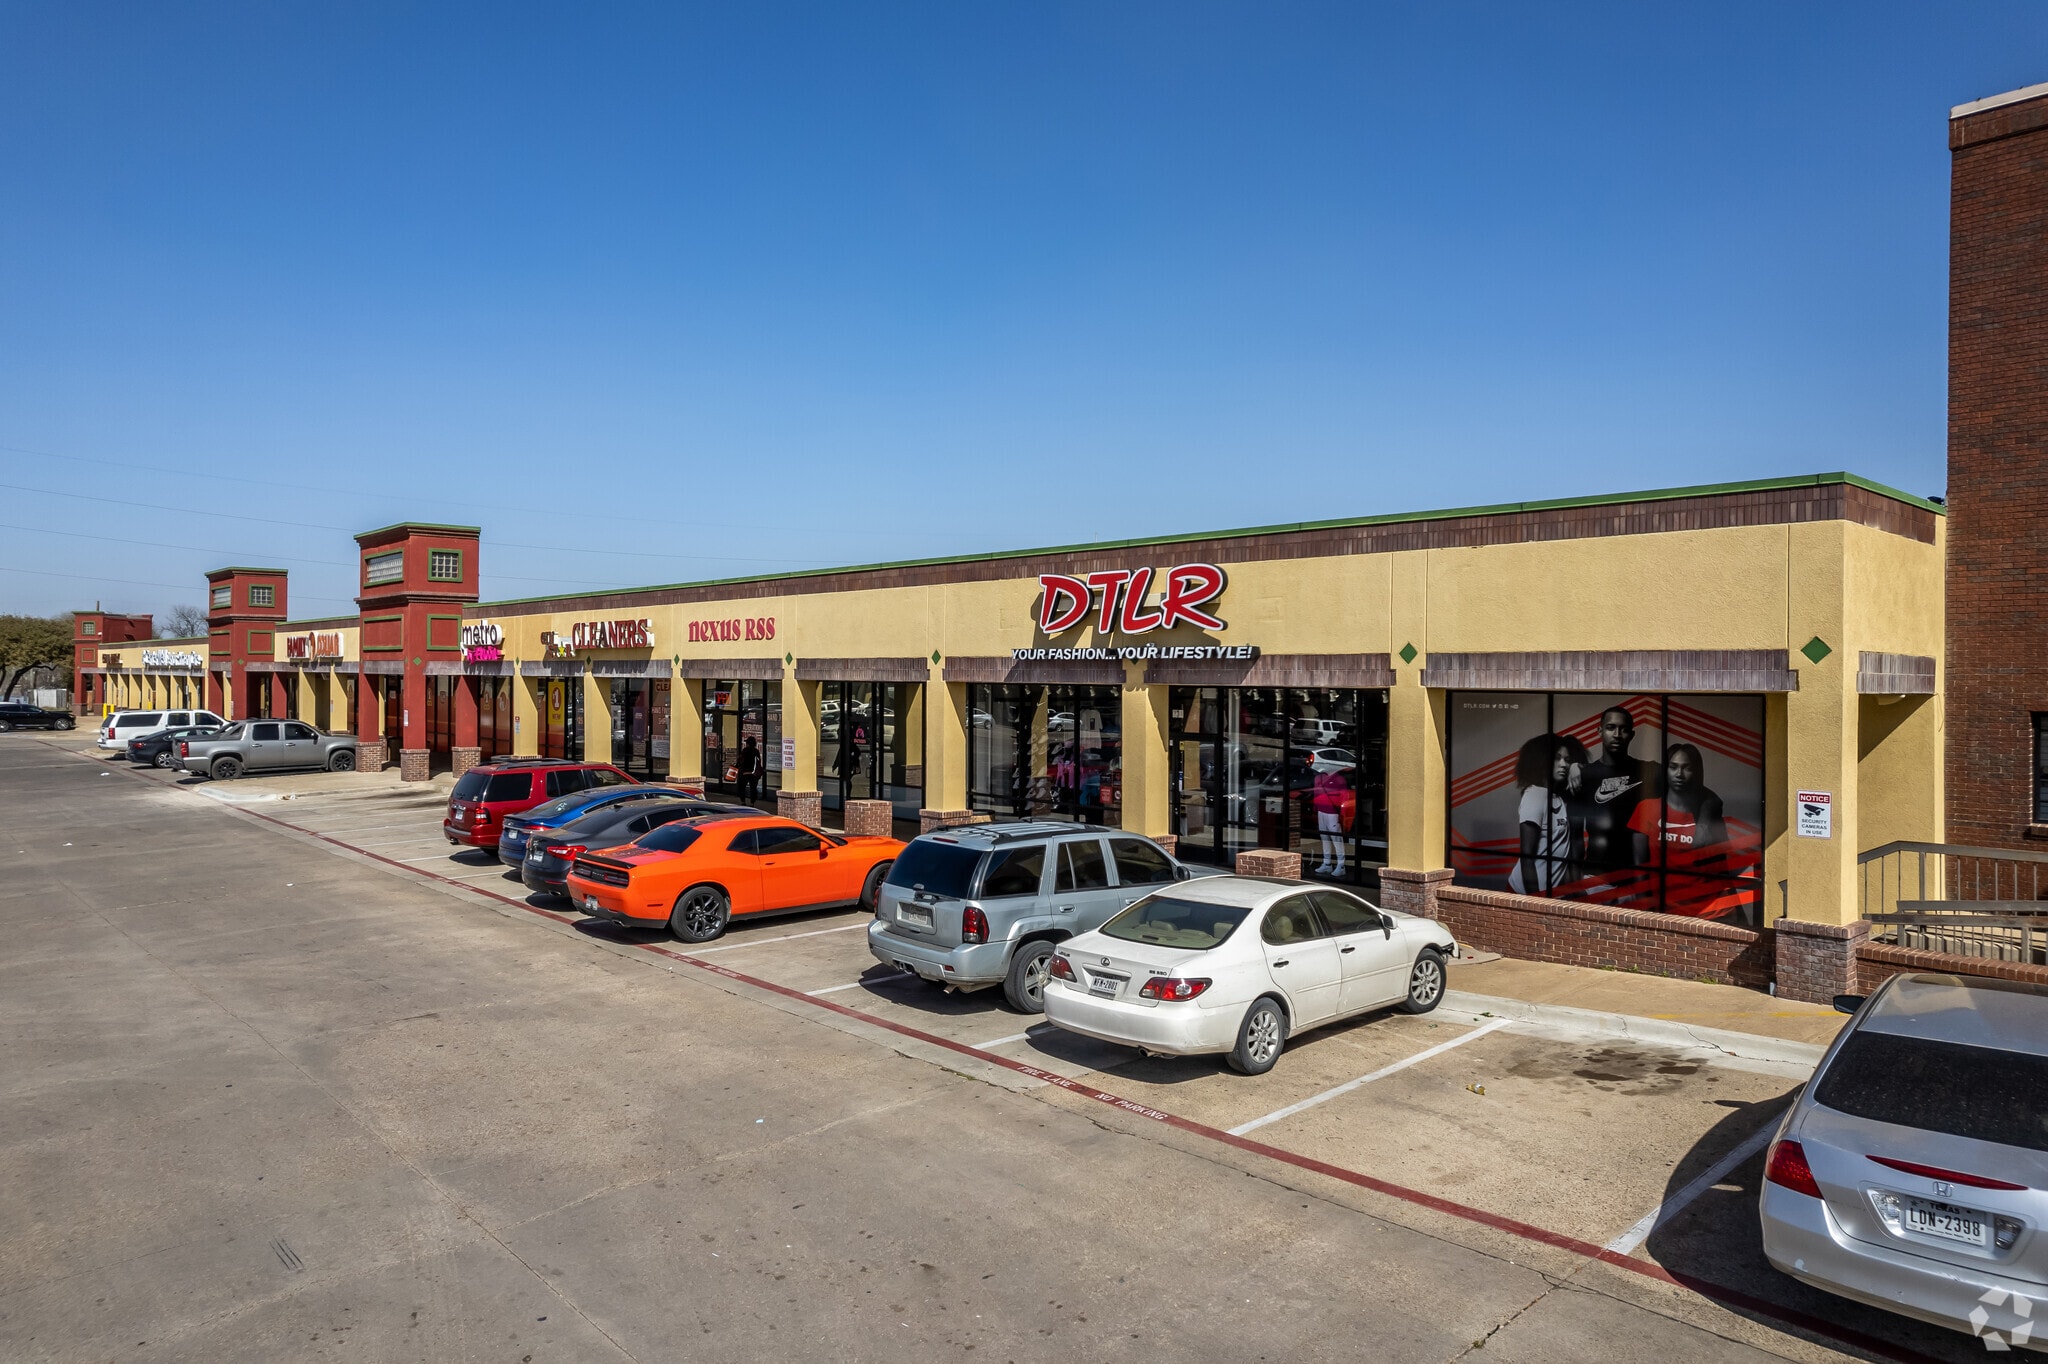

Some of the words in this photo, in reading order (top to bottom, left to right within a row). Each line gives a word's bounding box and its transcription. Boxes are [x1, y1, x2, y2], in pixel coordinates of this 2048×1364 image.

[1038, 562, 1227, 636] DTLR
[462, 619, 499, 645] metro
[572, 619, 650, 650] CLEANERS
[745, 617, 776, 641] RSS
[1011, 647, 1046, 660] YOUR
[1160, 645, 1253, 660] LIFESTYLE!
[1800, 794, 1829, 803] NOTICE
[1657, 832, 1678, 842] JST
[1680, 835, 1694, 844] DO
[1017, 1065, 1044, 1077] FIRE
[1043, 1073, 1076, 1089] LANE
[1094, 1092, 1116, 1102] NO
[1115, 1098, 1169, 1121] PARKING
[1930, 1202, 1961, 1215] TEXAS
